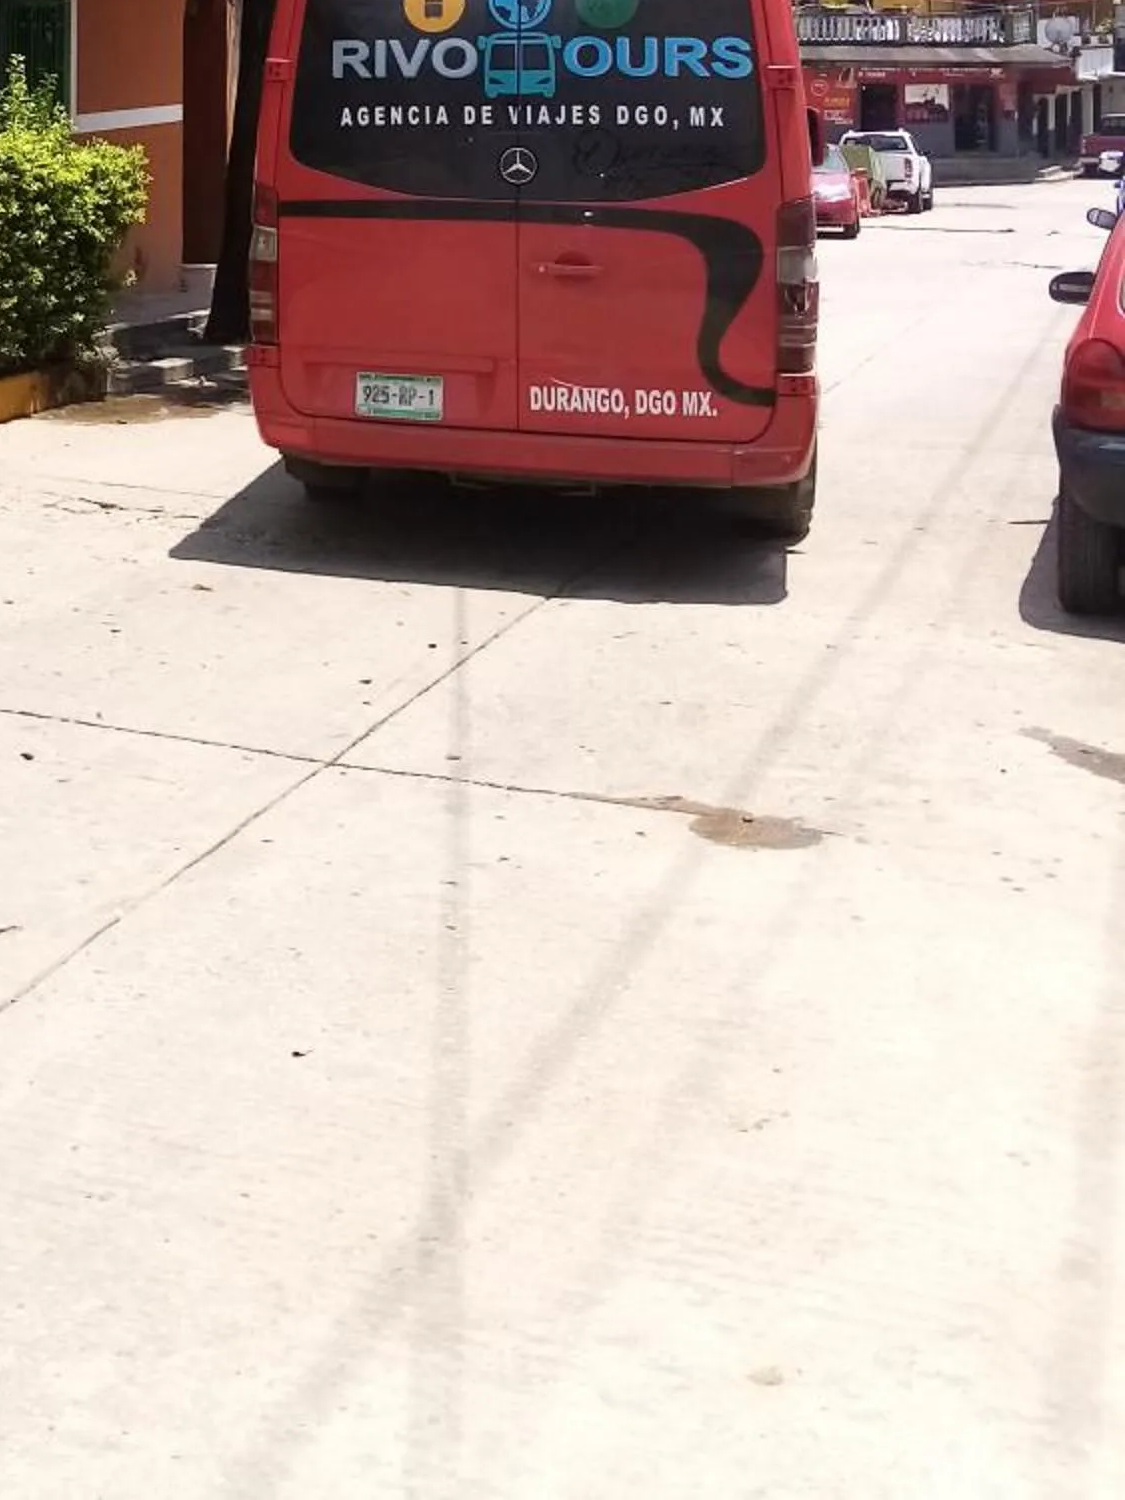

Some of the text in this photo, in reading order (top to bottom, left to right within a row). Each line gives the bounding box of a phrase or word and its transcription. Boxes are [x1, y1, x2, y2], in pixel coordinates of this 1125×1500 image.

[332, 37, 478, 79] RIVO
[340, 104, 725, 131] AGENCIA DE VIAJES DGO, MX
[530, 386, 718, 419] DURANGO, DGO MX.
